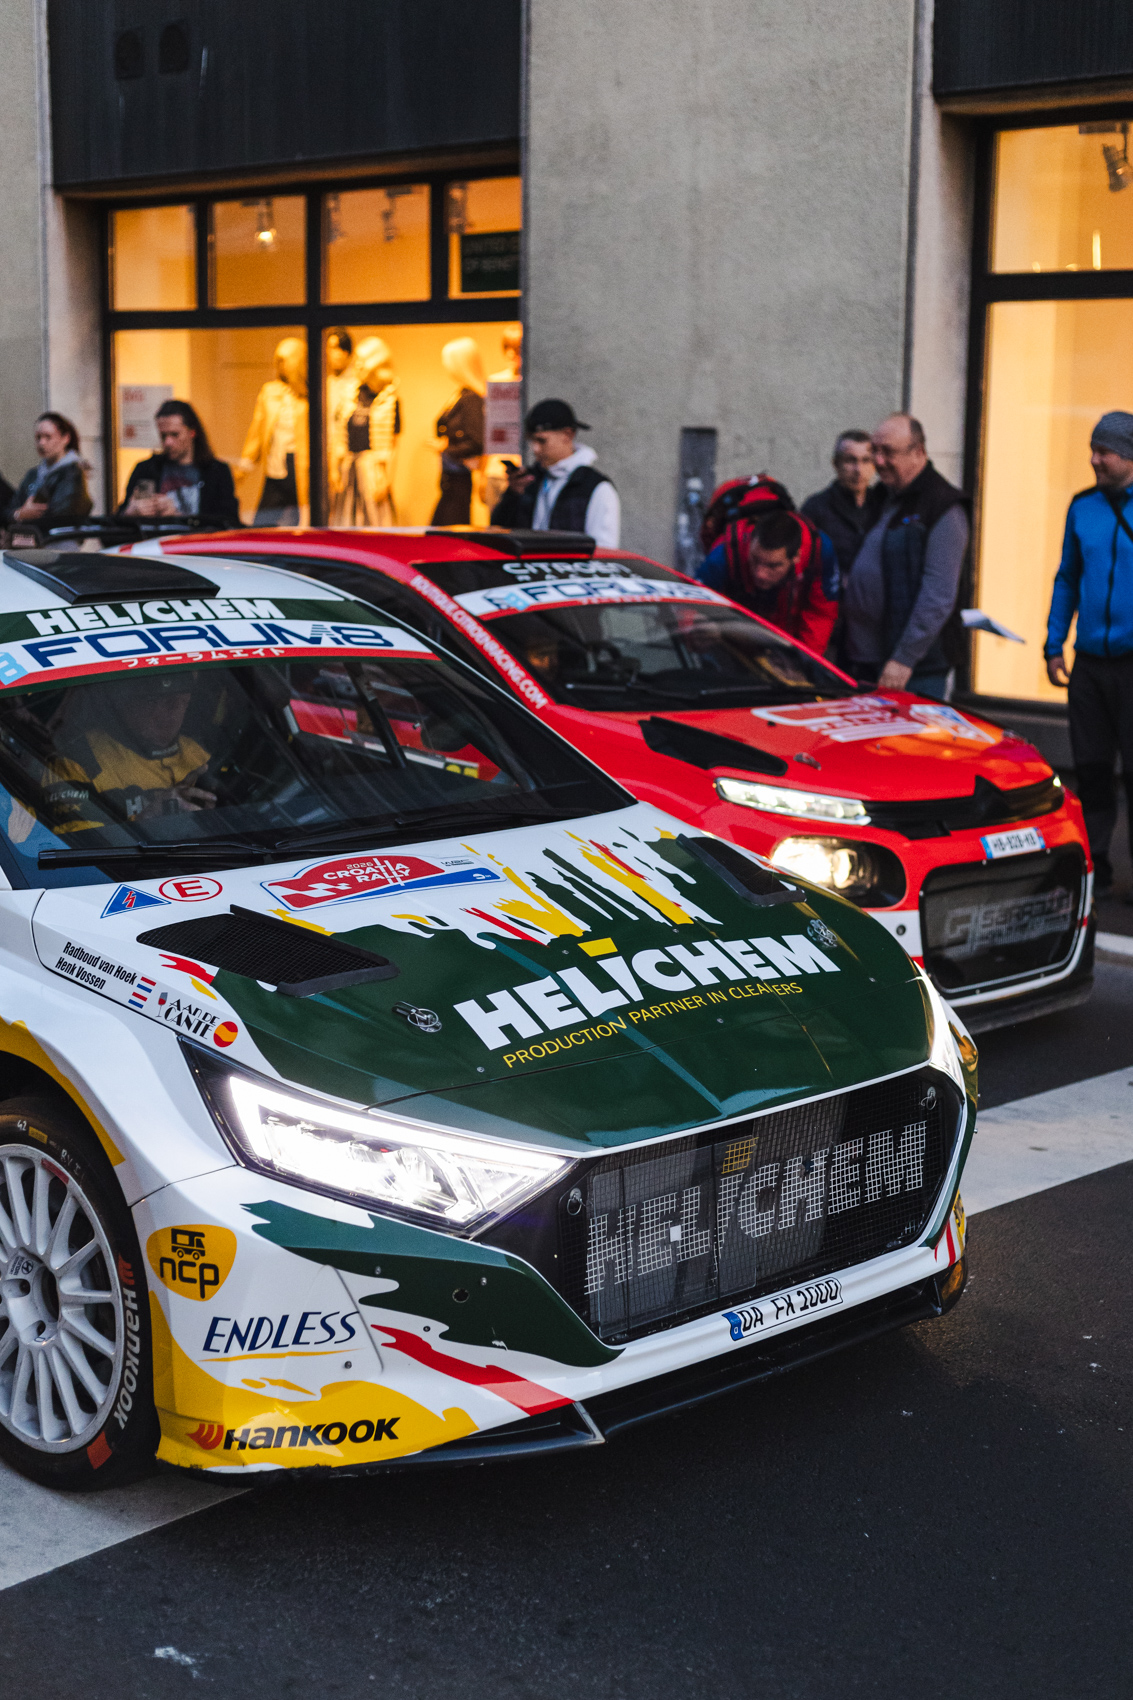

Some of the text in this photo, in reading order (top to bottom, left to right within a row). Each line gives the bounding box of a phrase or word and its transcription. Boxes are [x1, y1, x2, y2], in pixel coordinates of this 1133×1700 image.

[21, 623, 394, 668] FORUM8
[121, 647, 285, 668] フォーラムエイト
[323, 859, 409, 880] CROATIA
[355, 868, 411, 886] RALLY
[55, 956, 107, 990] Henk Vossen
[63, 941, 138, 985] Radboud van Hoek
[164, 1006, 216, 1040] CANTE
[502, 1015, 628, 1068] PRODUCTION
[628, 995, 704, 1024] PARTNER
[705, 989, 729, 1005] IN
[159, 1257, 219, 1299] ncp
[737, 1307, 763, 1332] DA
[797, 1280, 839, 1311] 1000
[202, 1311, 360, 1353] ENDLESS
